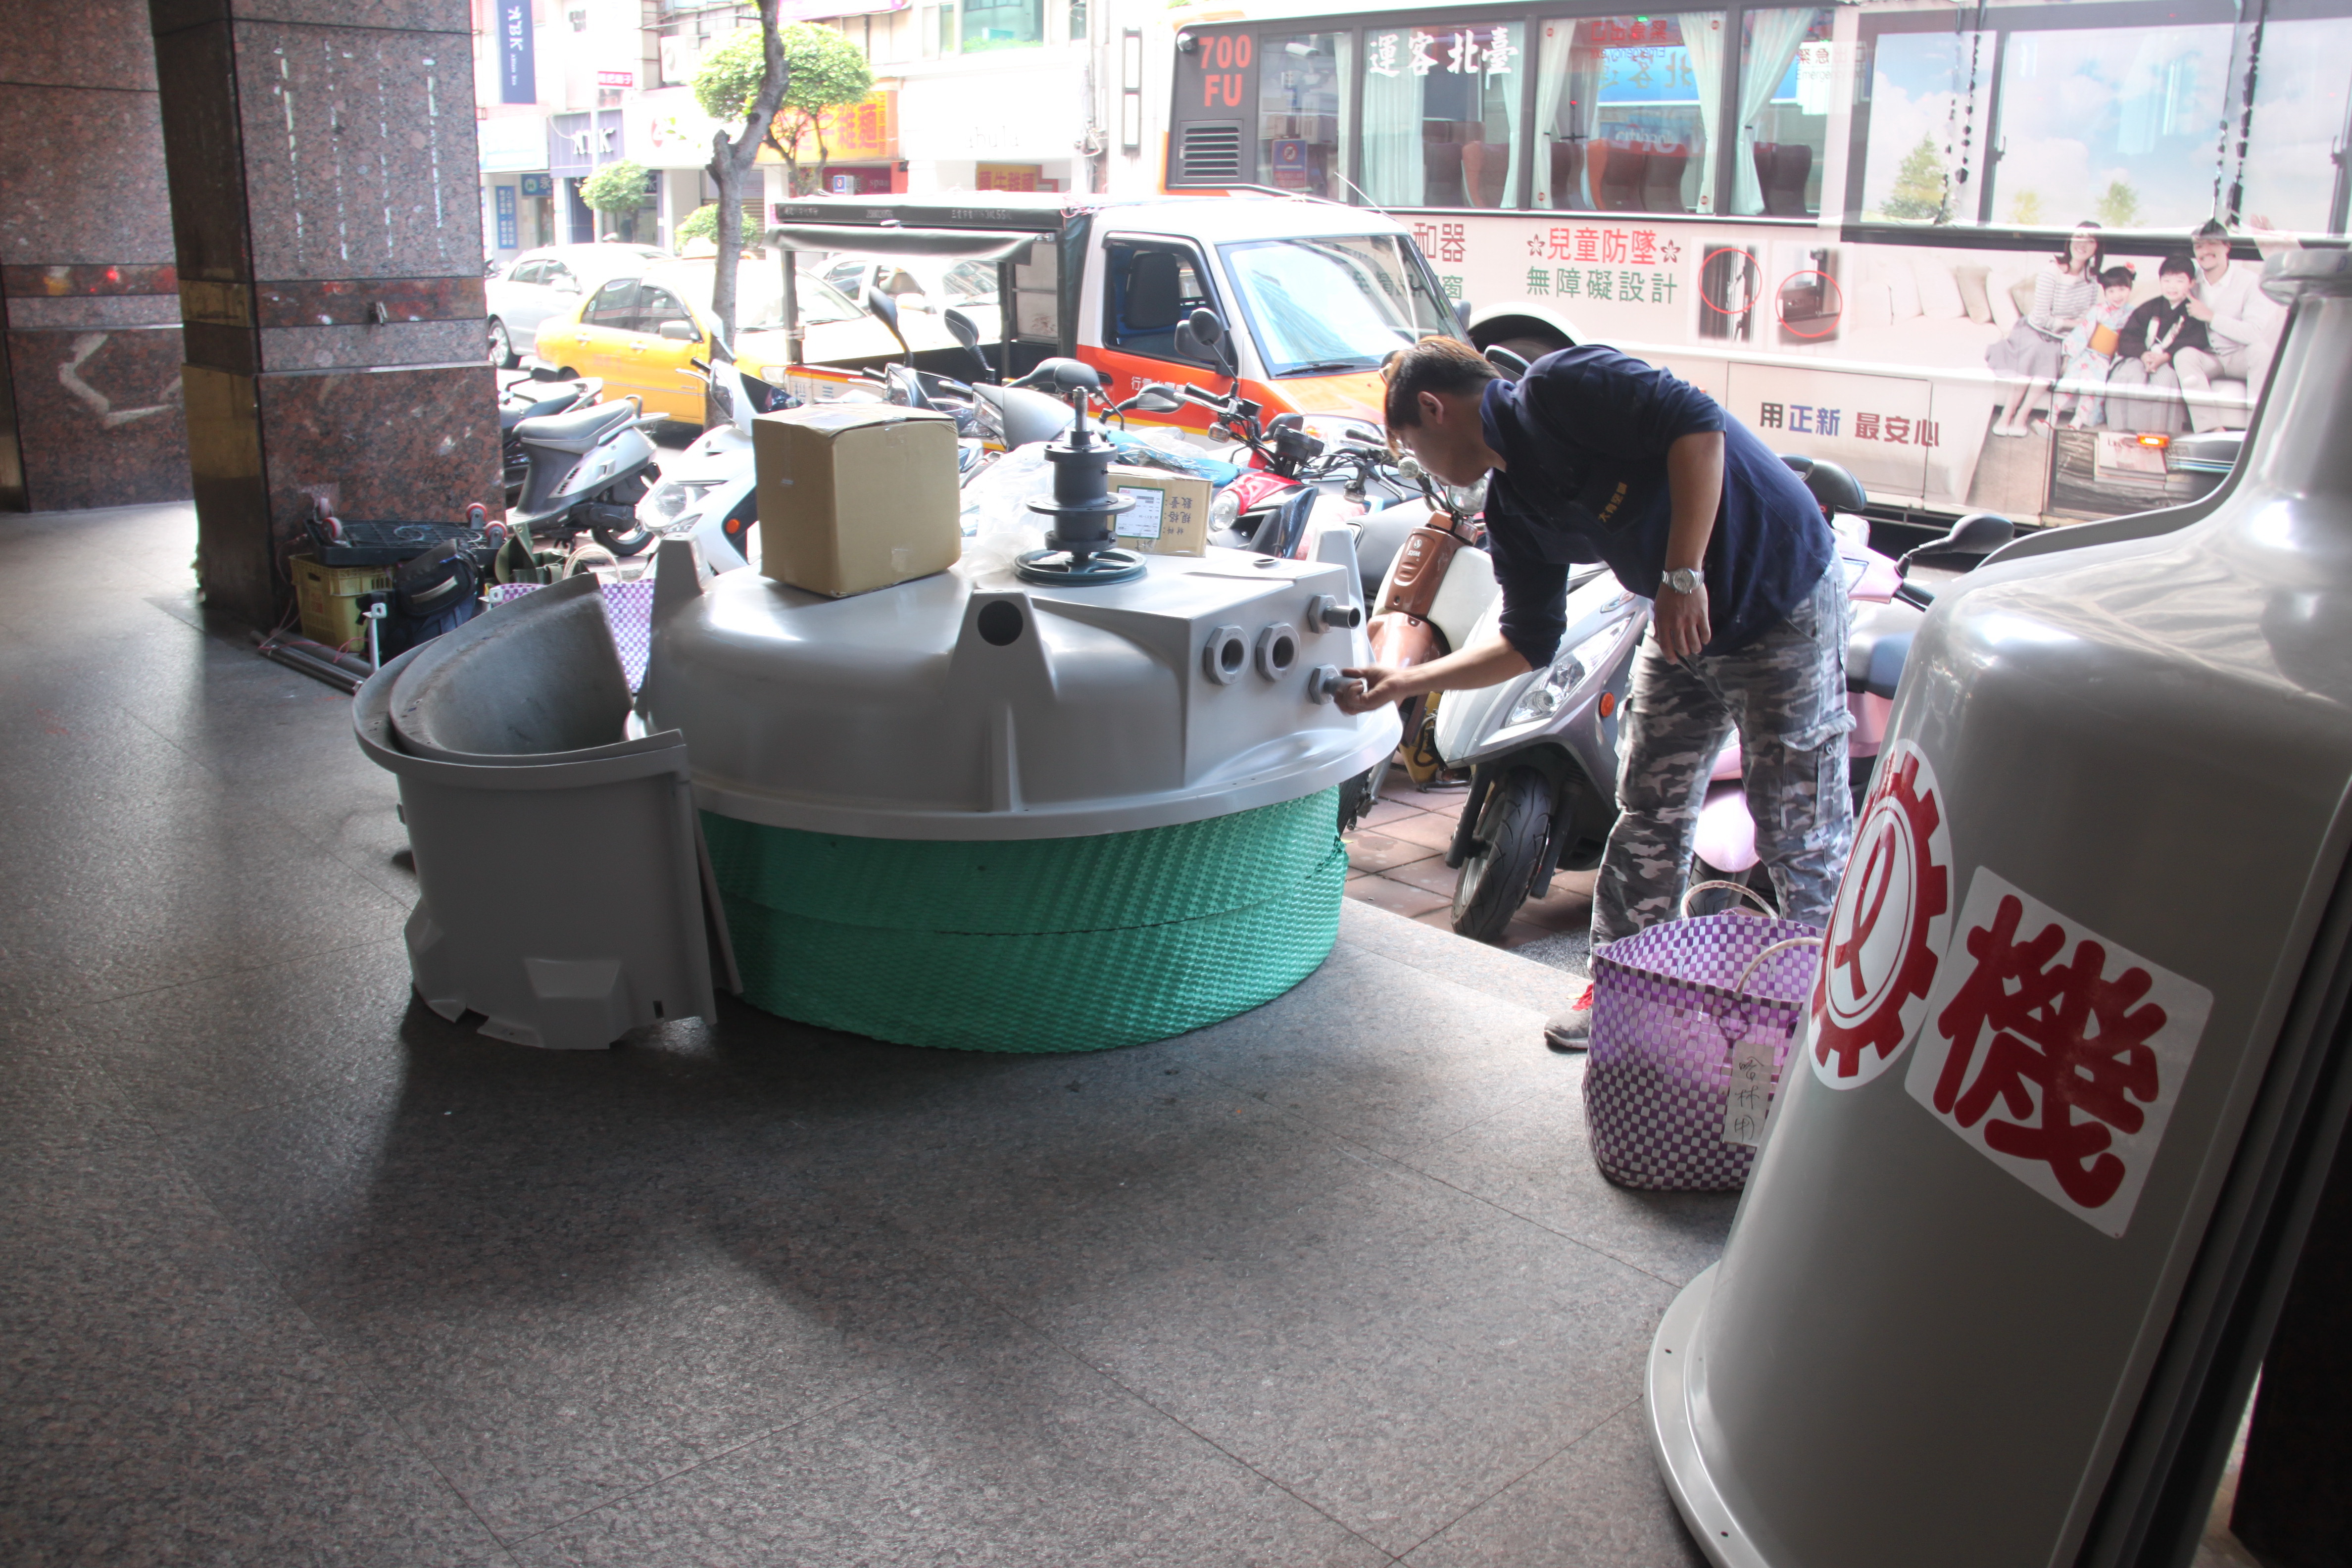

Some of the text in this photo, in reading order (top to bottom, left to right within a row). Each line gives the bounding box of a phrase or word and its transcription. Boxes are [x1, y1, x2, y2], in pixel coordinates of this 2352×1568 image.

[1198, 34, 1252, 69] 700
[1204, 73, 1242, 107] FU
[1408, 222, 1467, 263] 和器
[1547, 227, 1657, 265] 兒童防墜
[1526, 266, 1678, 304] 無障礙設計
[1760, 402, 1939, 447] 用正新 最安心
[1933, 894, 2167, 1209] 機
